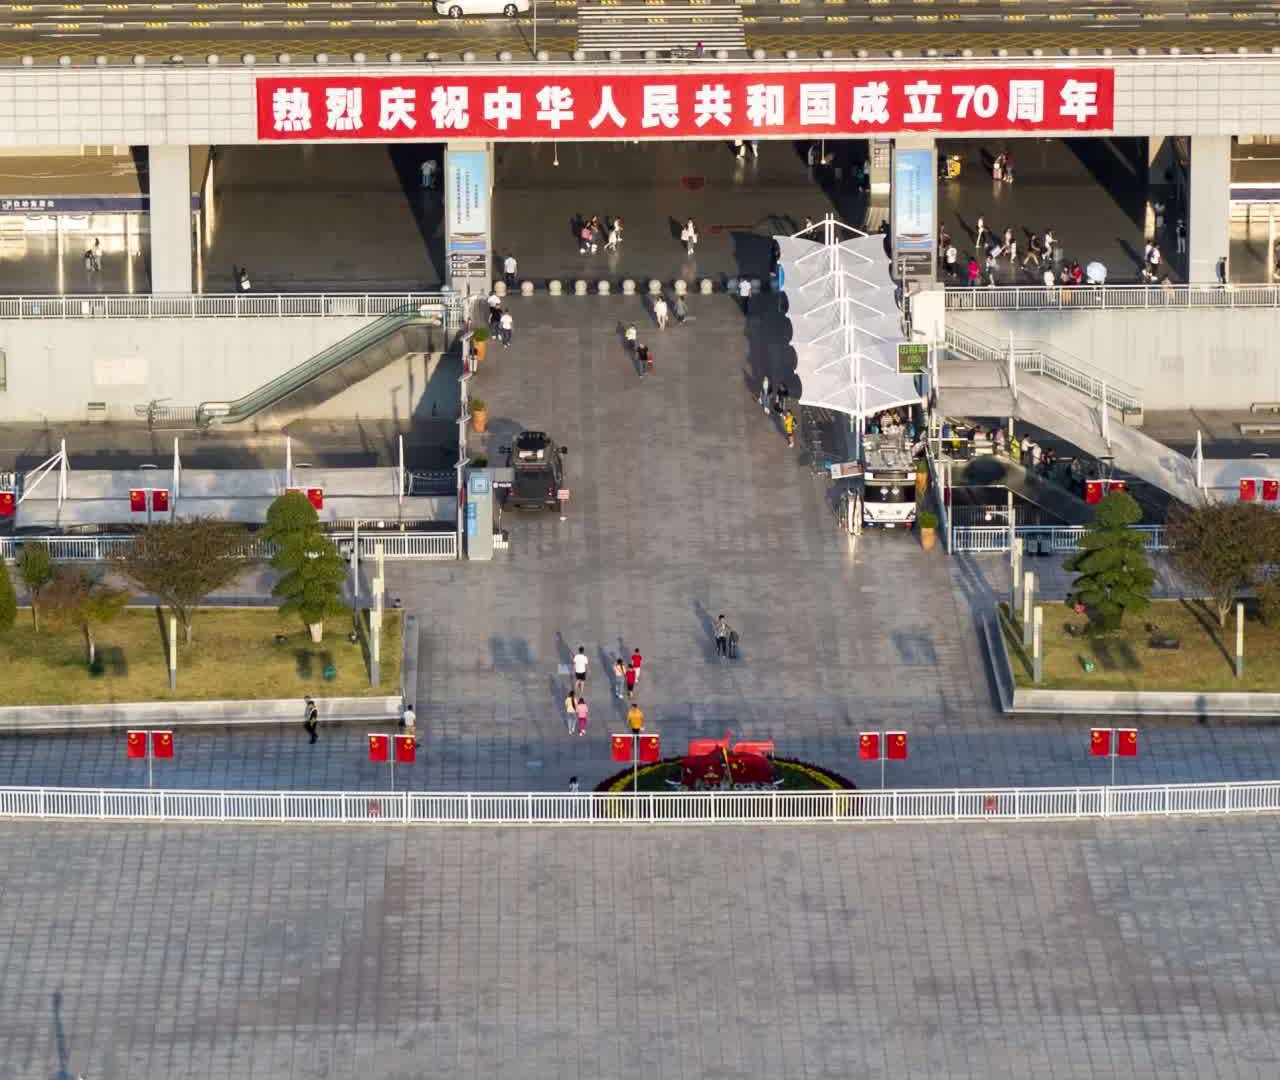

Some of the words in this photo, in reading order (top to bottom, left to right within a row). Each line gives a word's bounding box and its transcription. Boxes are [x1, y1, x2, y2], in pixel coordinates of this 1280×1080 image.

[271, 79, 1100, 132] 热烈庆祝中华人民共和国成立70周年
